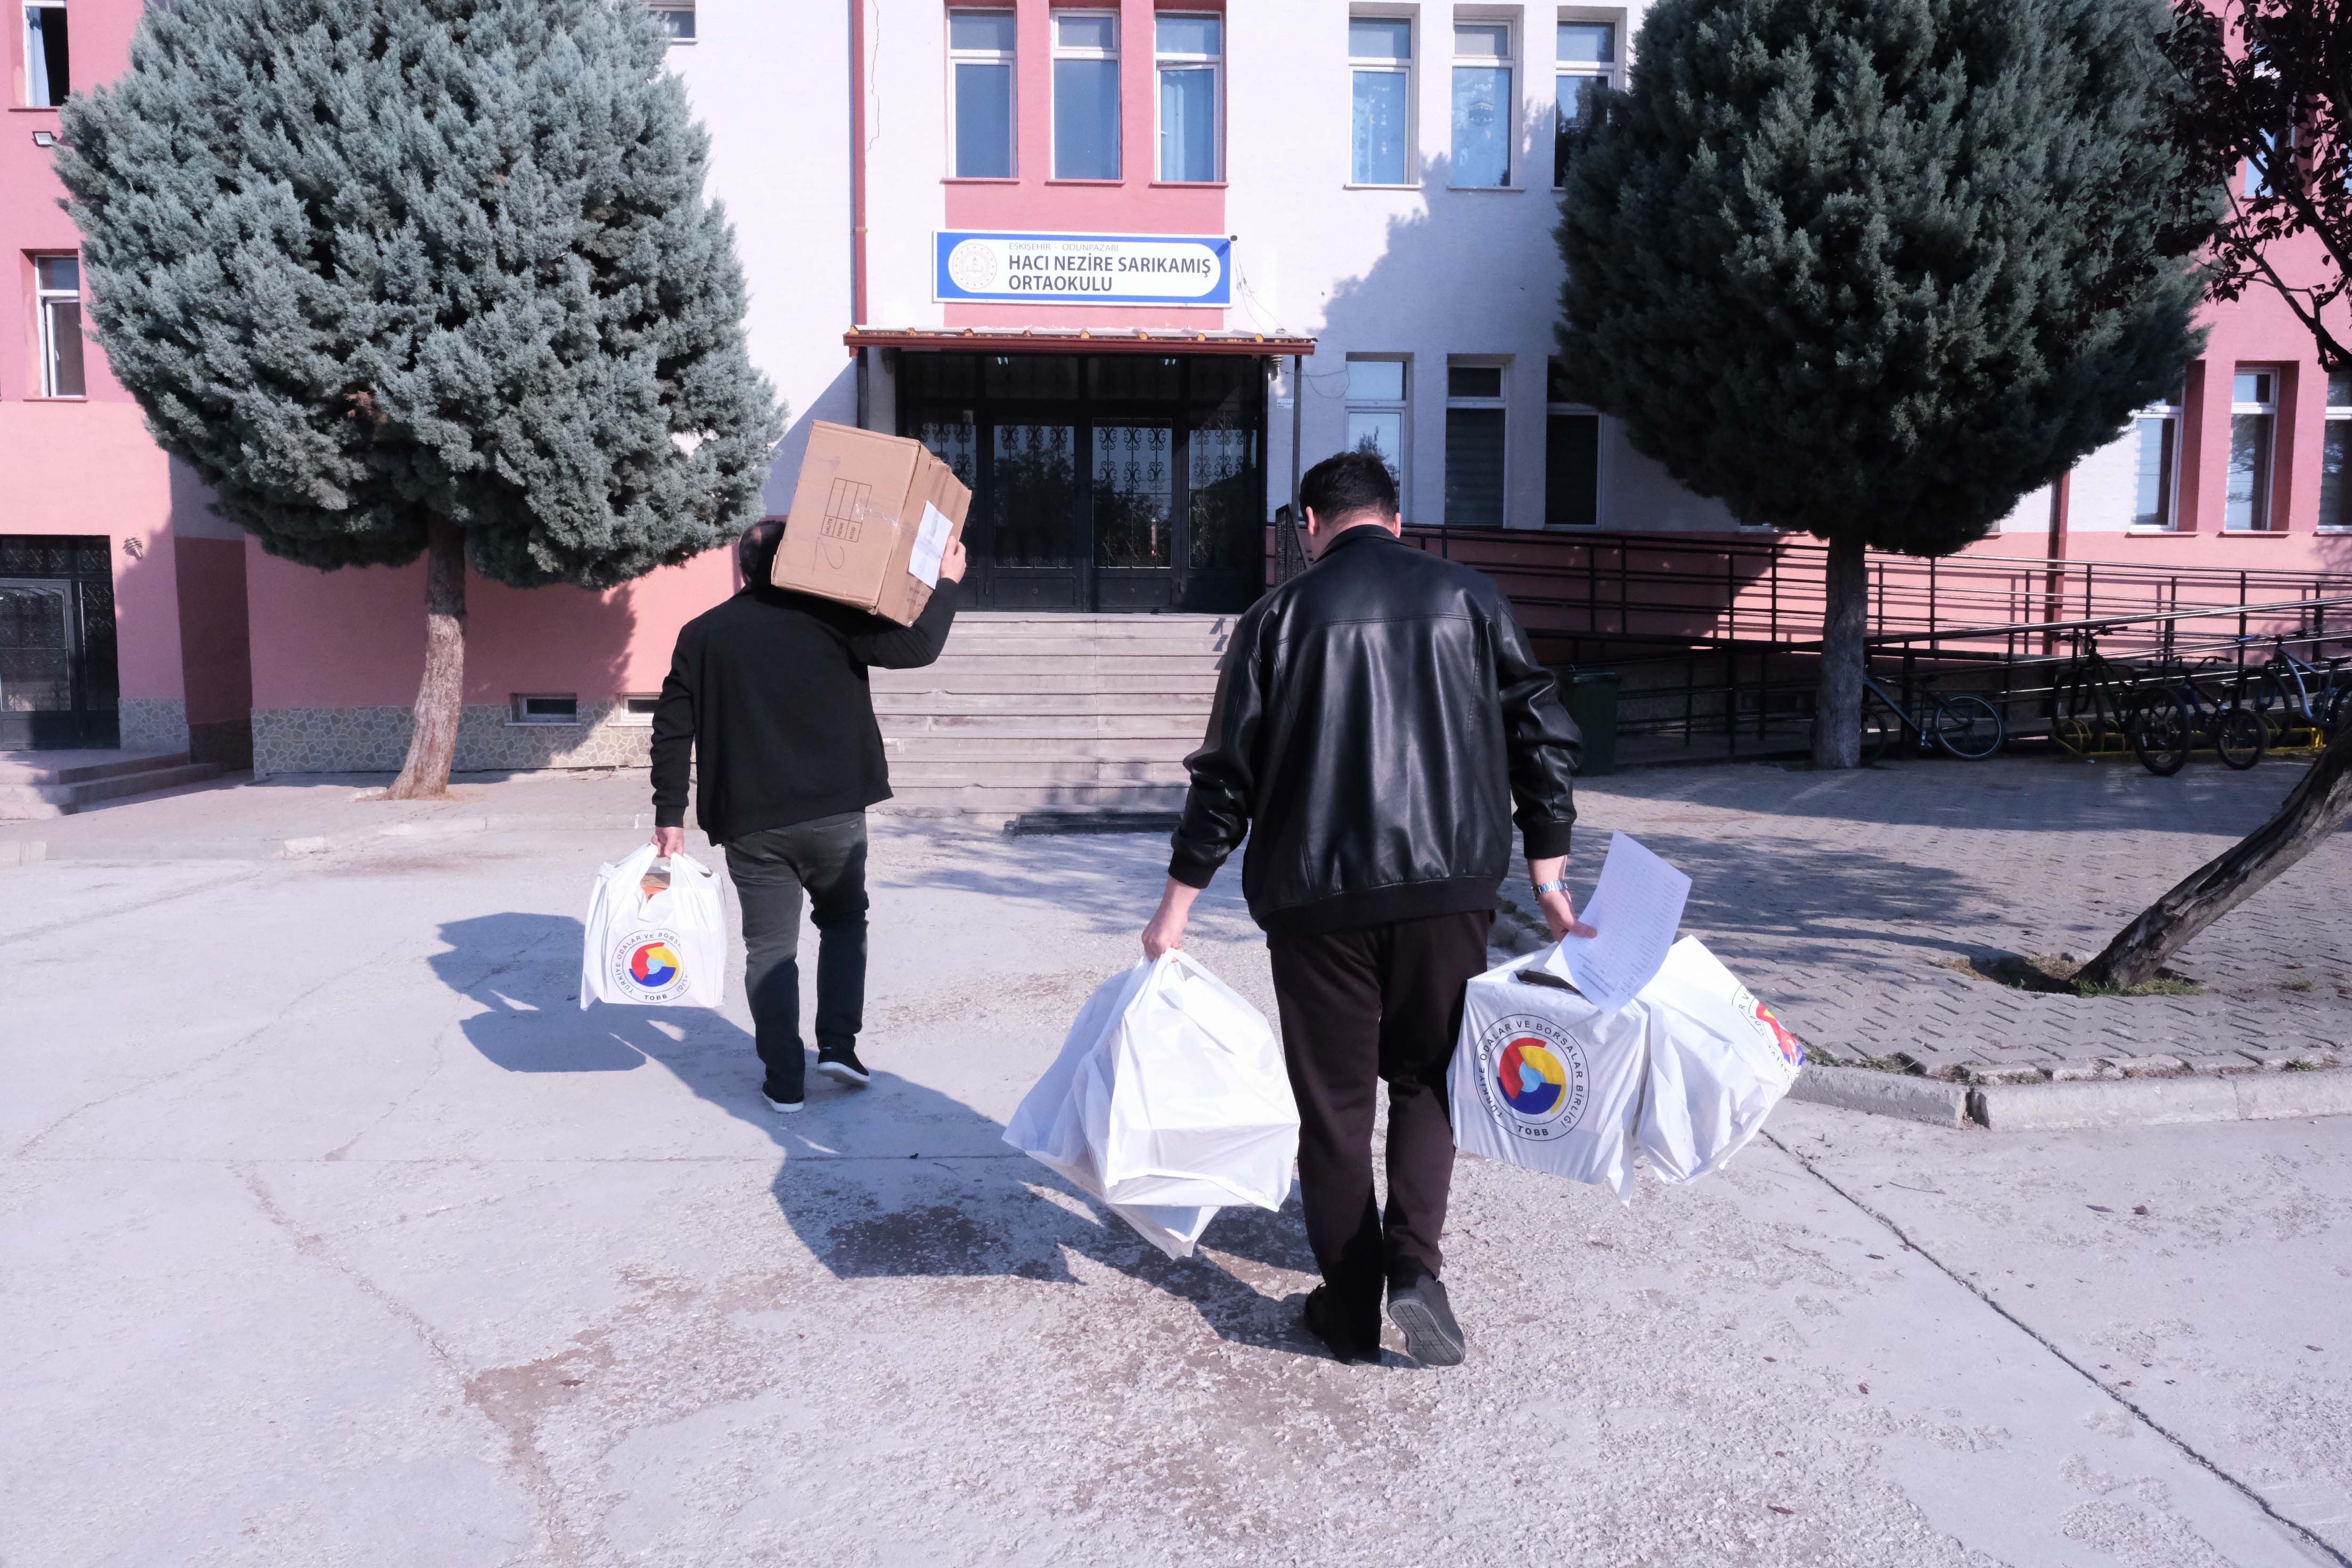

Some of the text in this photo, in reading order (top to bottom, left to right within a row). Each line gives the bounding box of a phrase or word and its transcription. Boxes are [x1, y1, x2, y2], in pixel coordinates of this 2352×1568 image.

[1009, 242, 1051, 251] ESKİŞEHİR
[1062, 243, 1118, 252] ODUNPAZARI
[1009, 255, 1049, 271] HACI
[1054, 252, 1113, 272] NEZİRE
[1117, 257, 1211, 278] SARIKAMIŞ
[1008, 275, 1112, 292] ORTAOKULU
[617, 935, 641, 959] ODALAR
[1480, 1023, 1512, 1061] ODALAR
[1536, 1023, 1583, 1079] BORSALAR
[1517, 1125, 1549, 1137] TOBB
